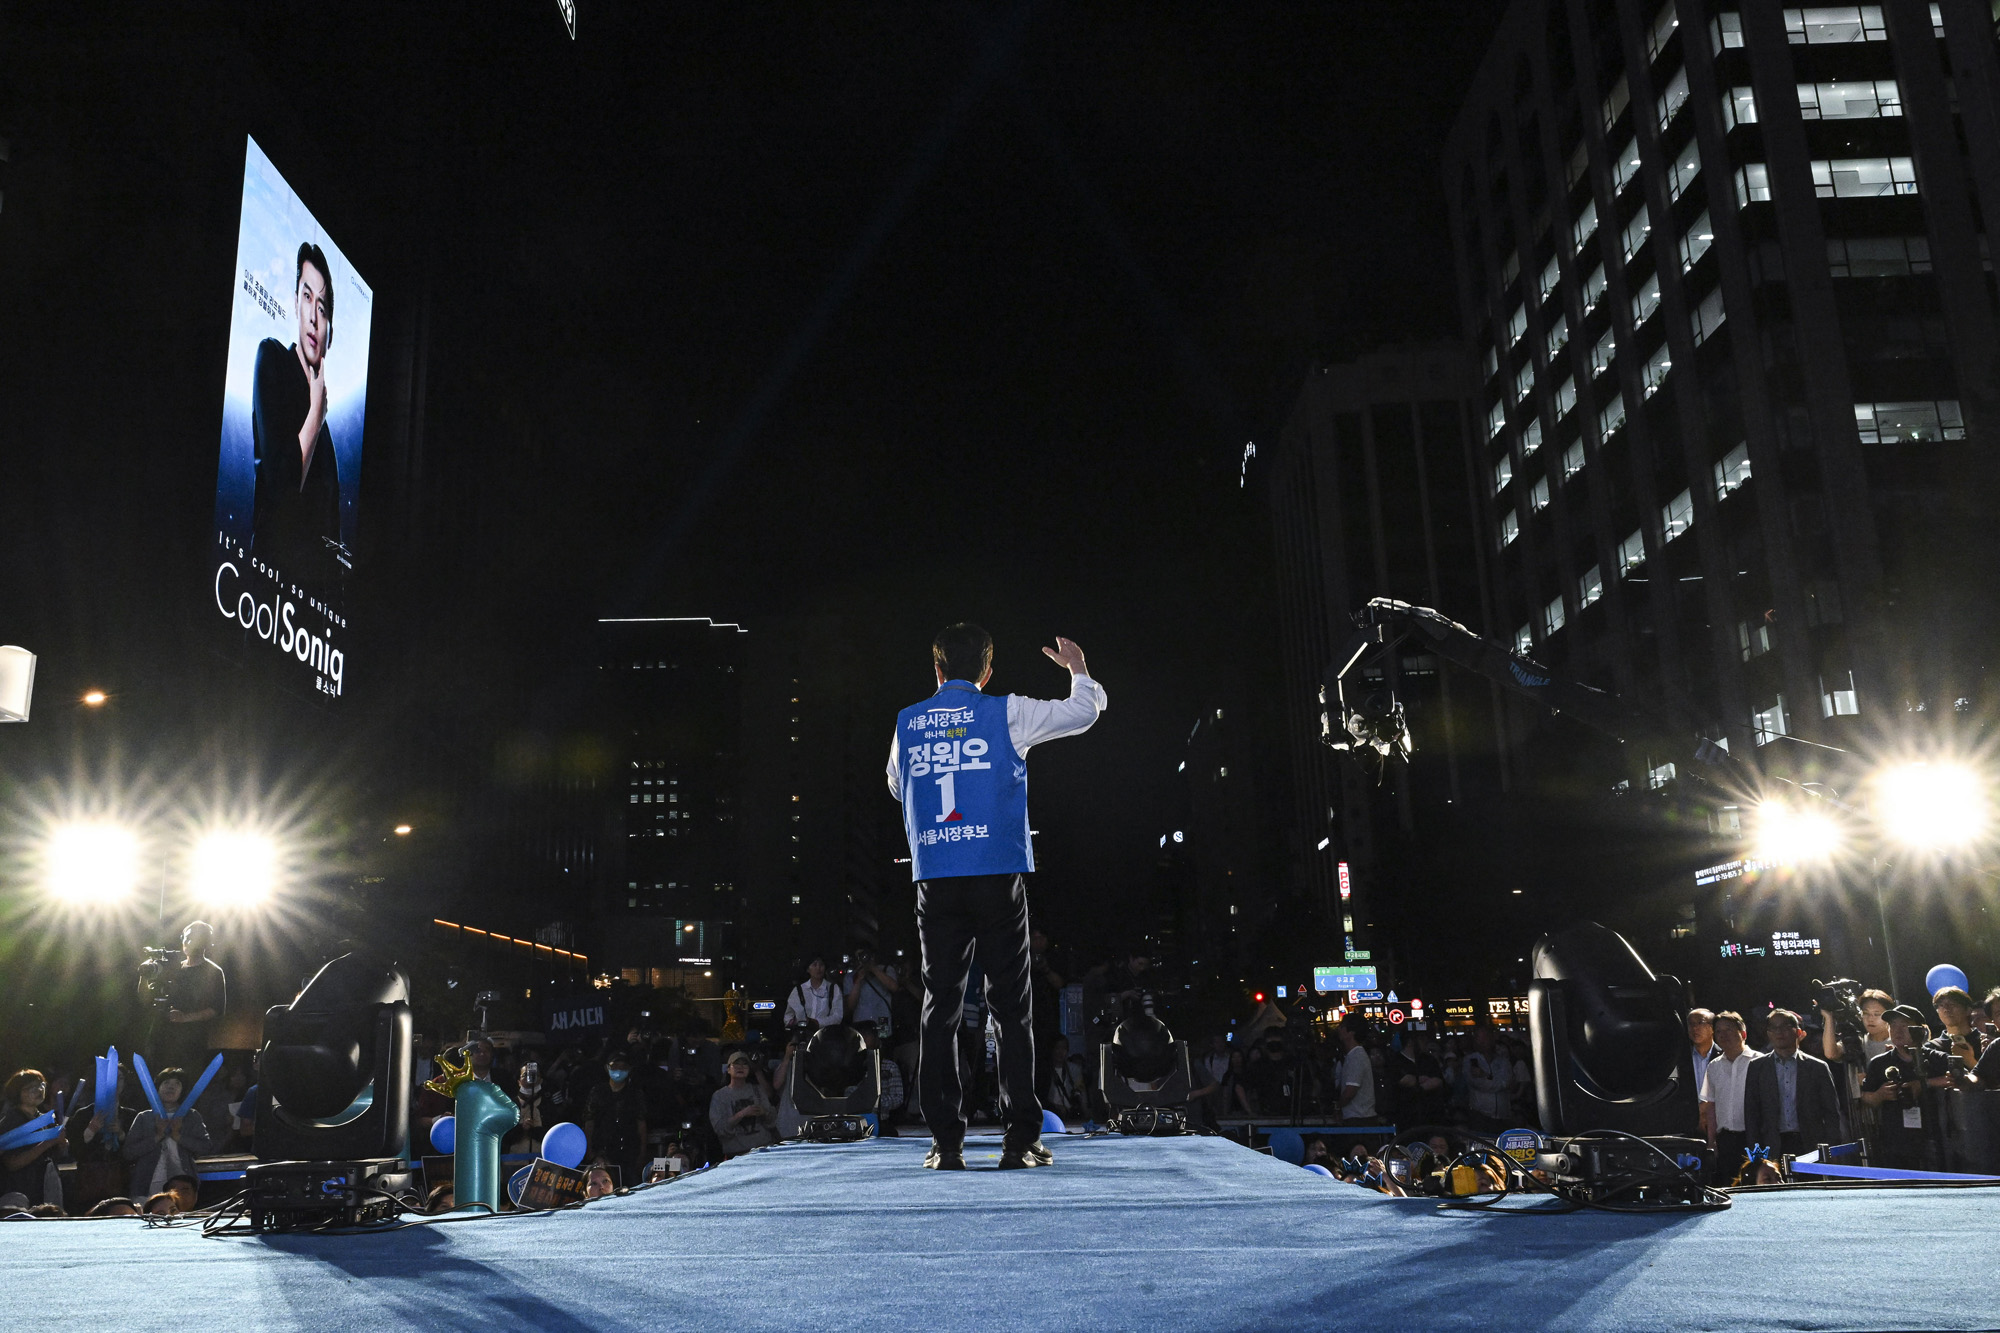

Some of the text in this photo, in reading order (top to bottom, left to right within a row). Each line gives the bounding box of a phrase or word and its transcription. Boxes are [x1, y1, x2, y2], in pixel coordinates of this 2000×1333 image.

[219, 531, 346, 628] It's cool, so unique
[215, 562, 344, 696] CoolSoniq
[1509, 661, 1550, 687] TRIANGLE
[316, 676, 336, 698] 쿨소닉
[907, 710, 975, 731] 서울시장후보
[924, 730, 946, 739] 하나씩
[908, 738, 991, 777] 정원오
[935, 772, 963, 823] 1
[917, 824, 989, 846] 서울시장후보
[1340, 871, 1349, 889] PC
[1773, 939, 1820, 949] 정형외과의원
[551, 1006, 604, 1031] 새시대
[1504, 1140, 1535, 1149] 서울시장은
